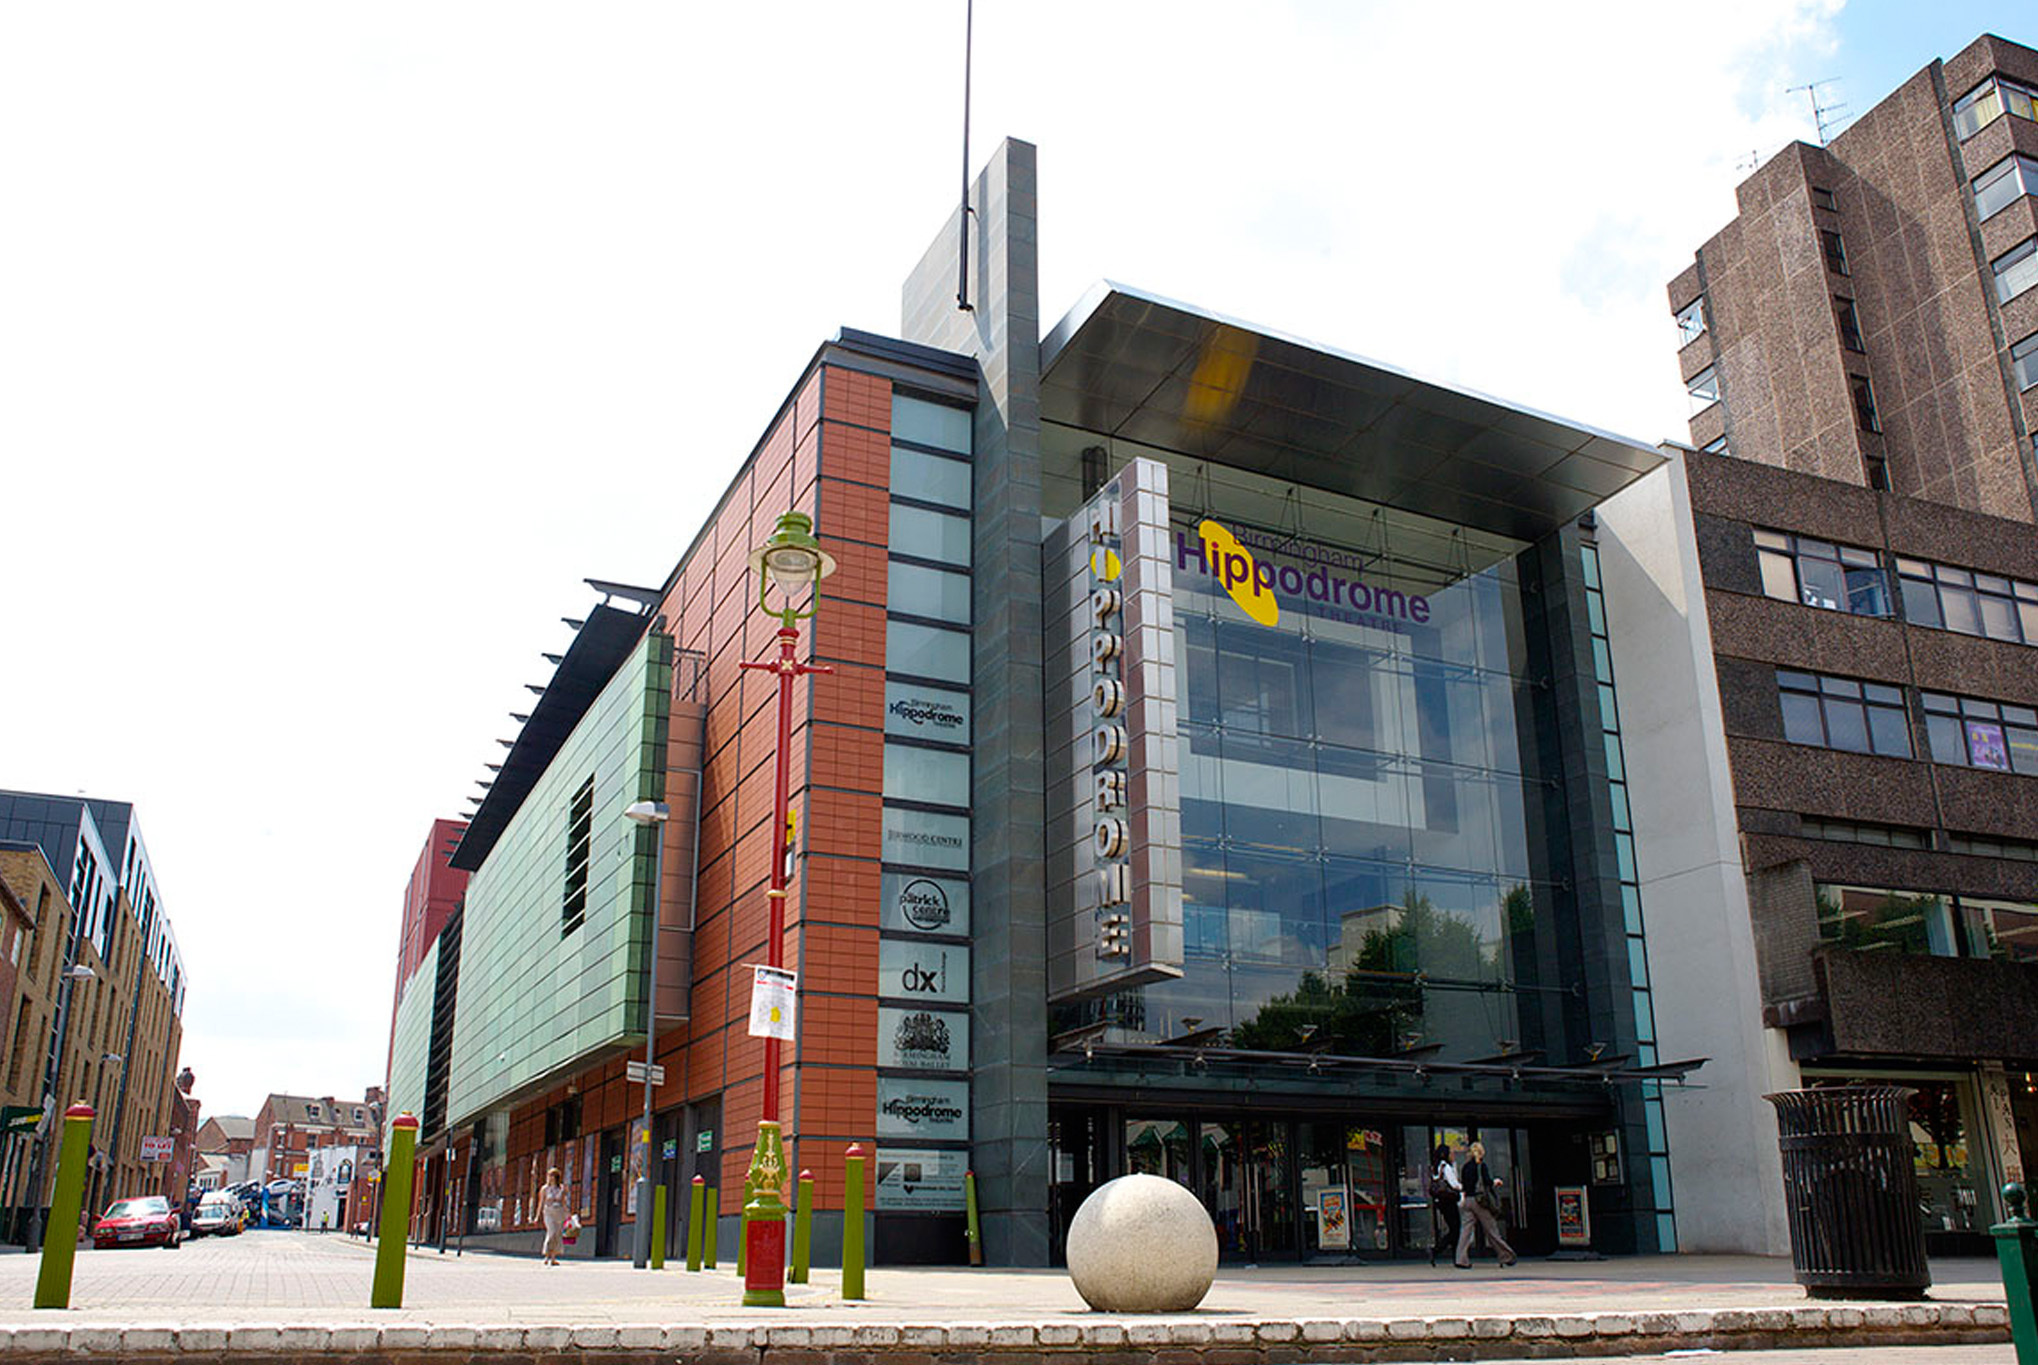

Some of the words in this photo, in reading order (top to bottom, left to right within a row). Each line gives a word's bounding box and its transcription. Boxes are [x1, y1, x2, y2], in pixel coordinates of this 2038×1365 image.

[1233, 522, 1363, 572] Birmingham
[1177, 532, 1430, 623] Hippodrome
[1318, 605, 1404, 634] THEATRE
[889, 701, 963, 725] Hippodrome
[1090, 501, 1131, 957] HIPPODROME
[902, 962, 937, 993] dx
[882, 1099, 962, 1123] Hippodrome
